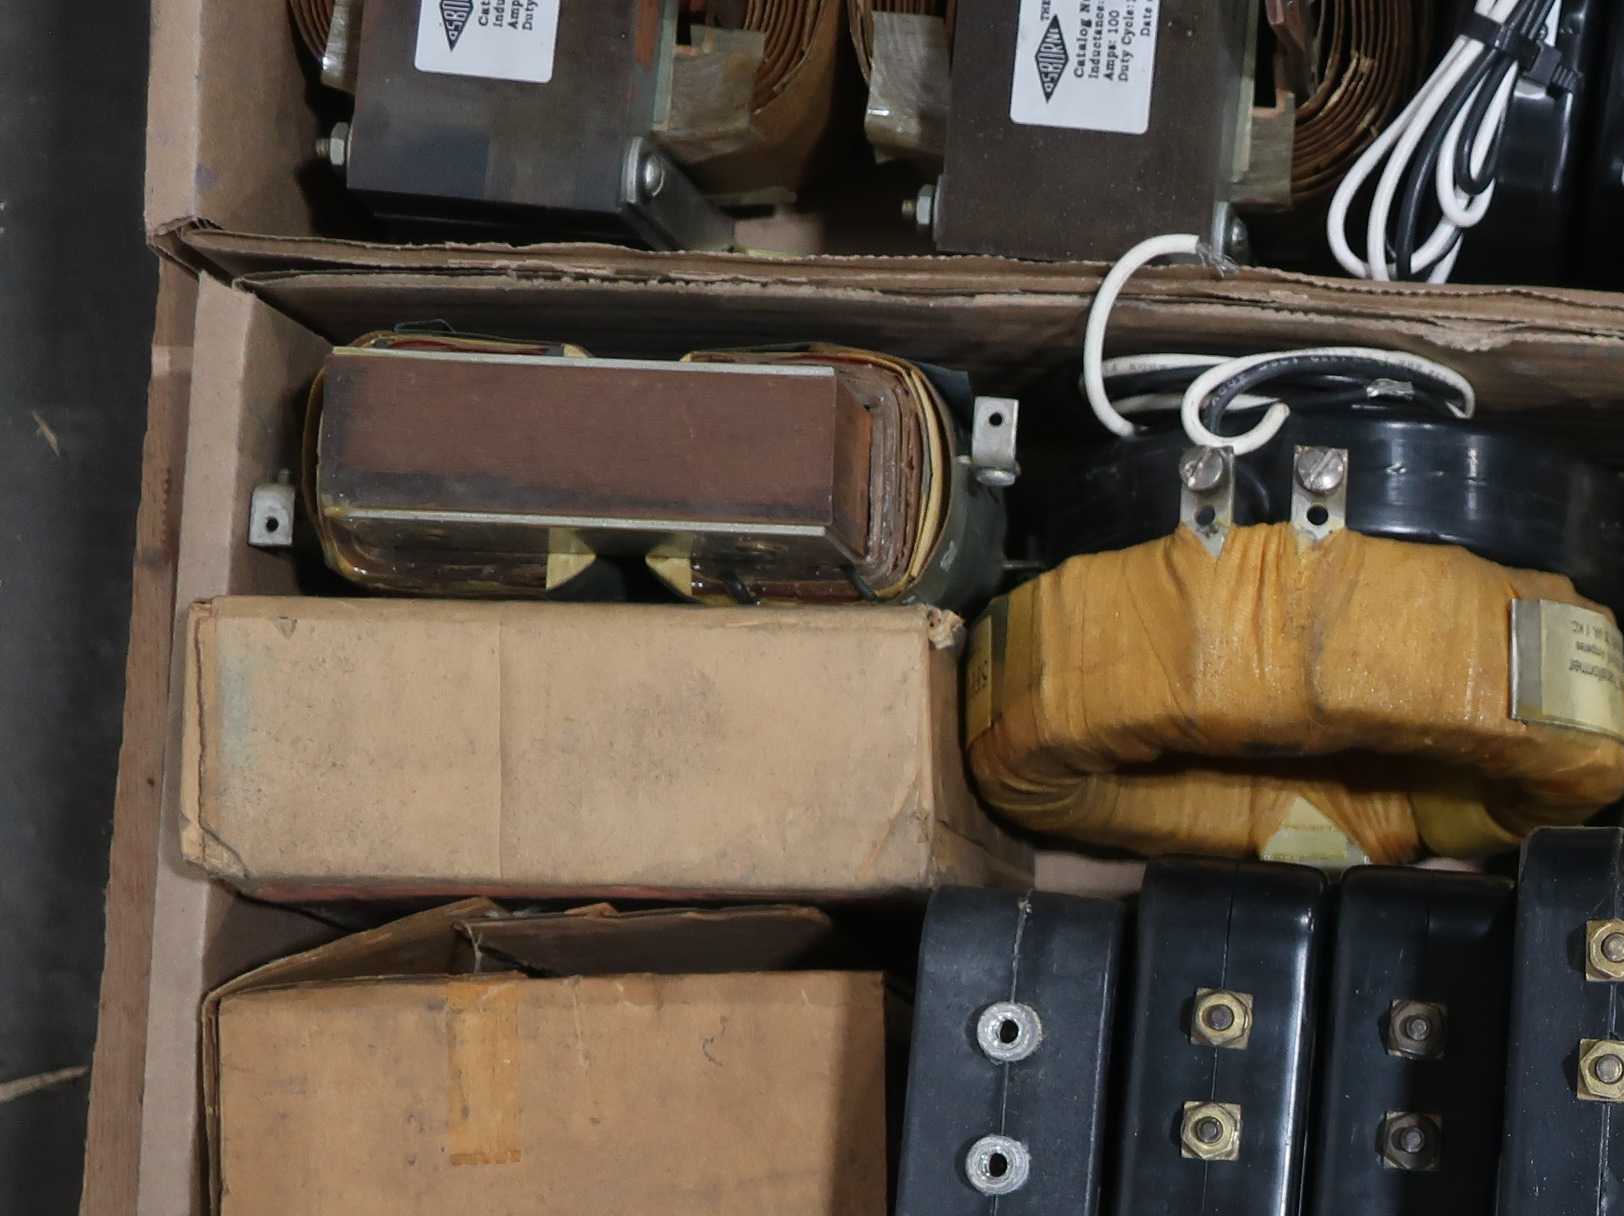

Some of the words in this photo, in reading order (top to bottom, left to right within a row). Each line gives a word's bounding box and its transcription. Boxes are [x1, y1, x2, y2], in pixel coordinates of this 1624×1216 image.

[1140, 7, 1152, 36] Date
[1074, 18, 1092, 78] Catalog
[1119, 50, 1133, 82] Duty
